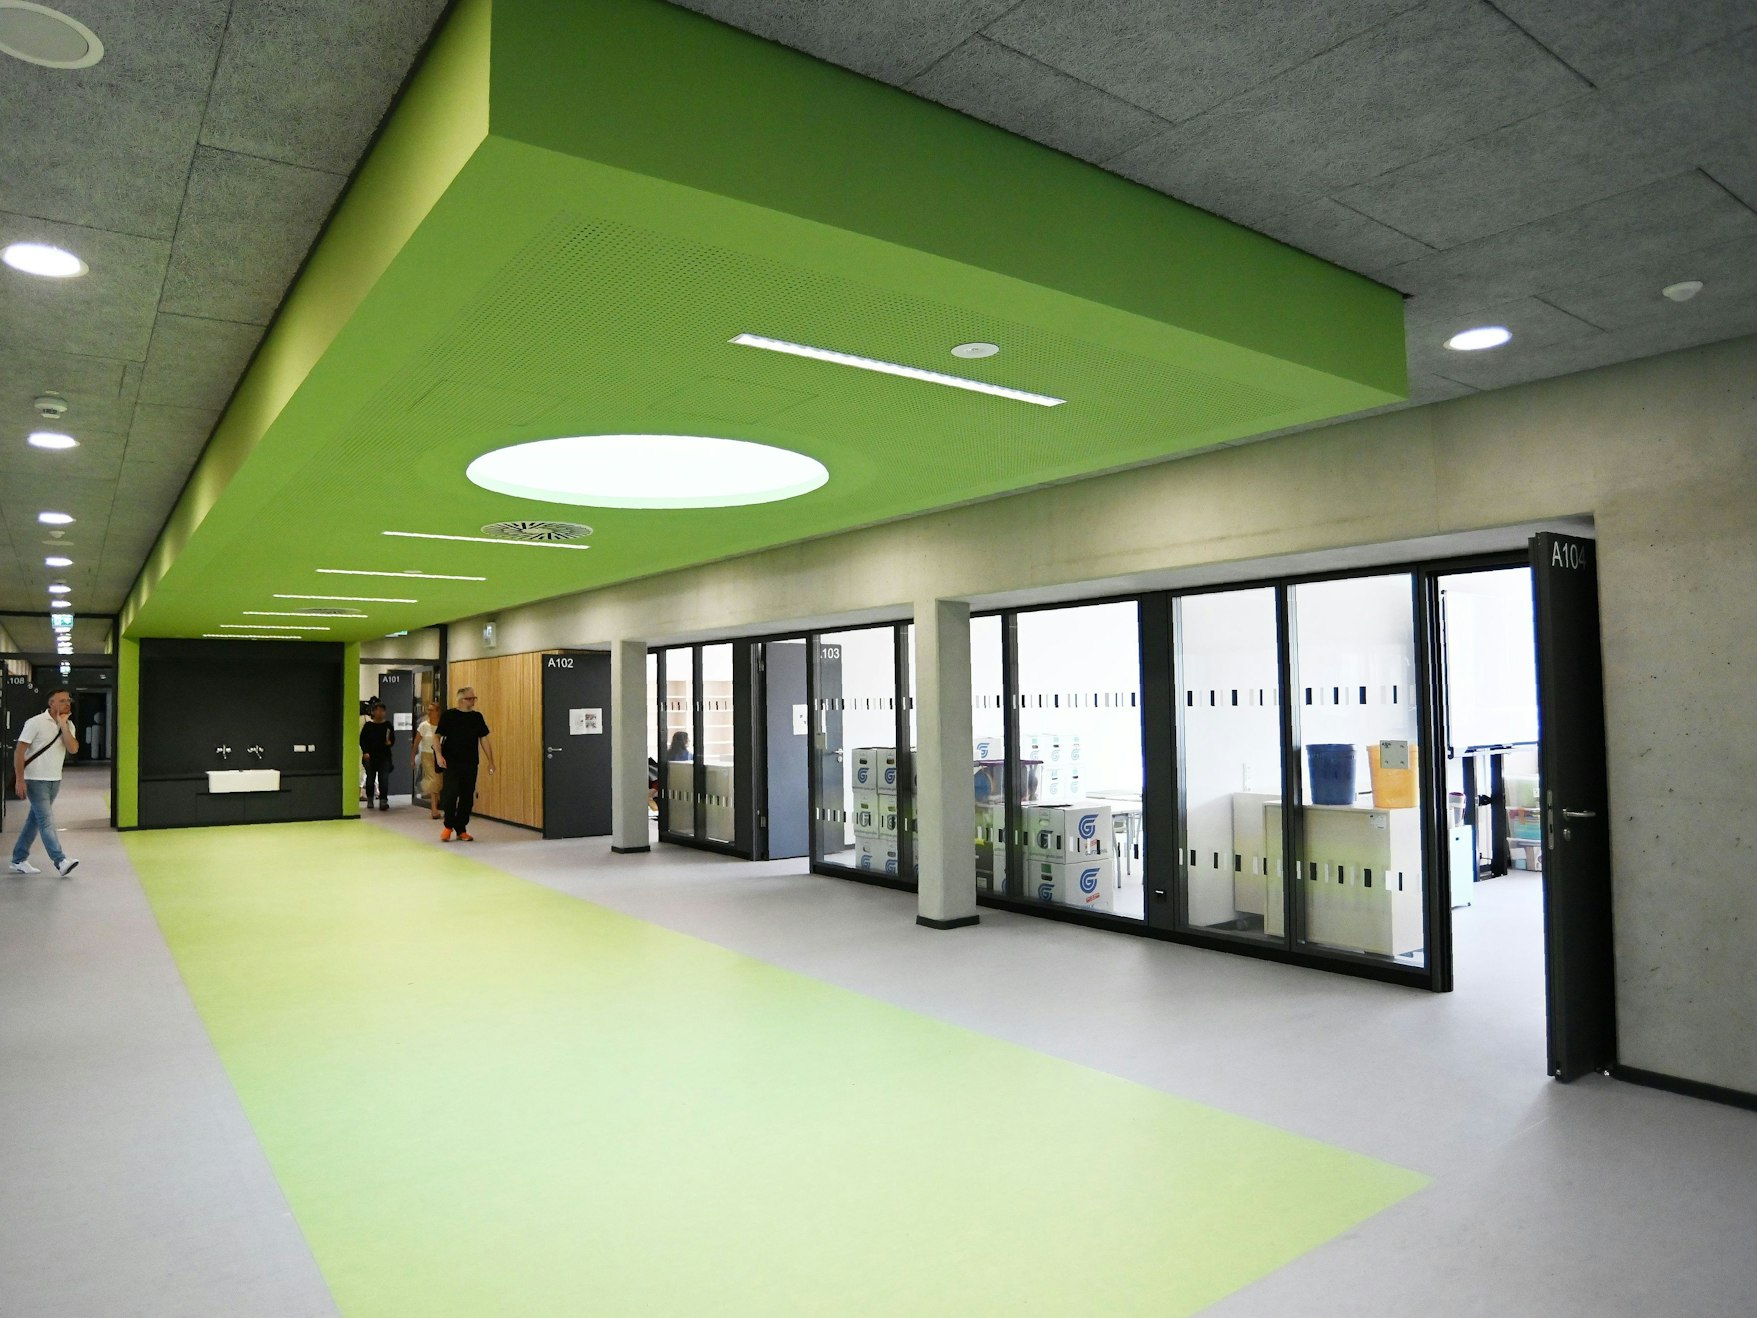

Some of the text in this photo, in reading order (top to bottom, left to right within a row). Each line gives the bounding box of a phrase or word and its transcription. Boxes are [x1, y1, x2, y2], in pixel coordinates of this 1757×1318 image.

[1552, 541, 1586, 569] A104
[820, 648, 840, 659] 103
[548, 658, 573, 668] A102
[7, 677, 24, 685] 108
[1079, 814, 1099, 840] G
[1080, 868, 1100, 894] G
